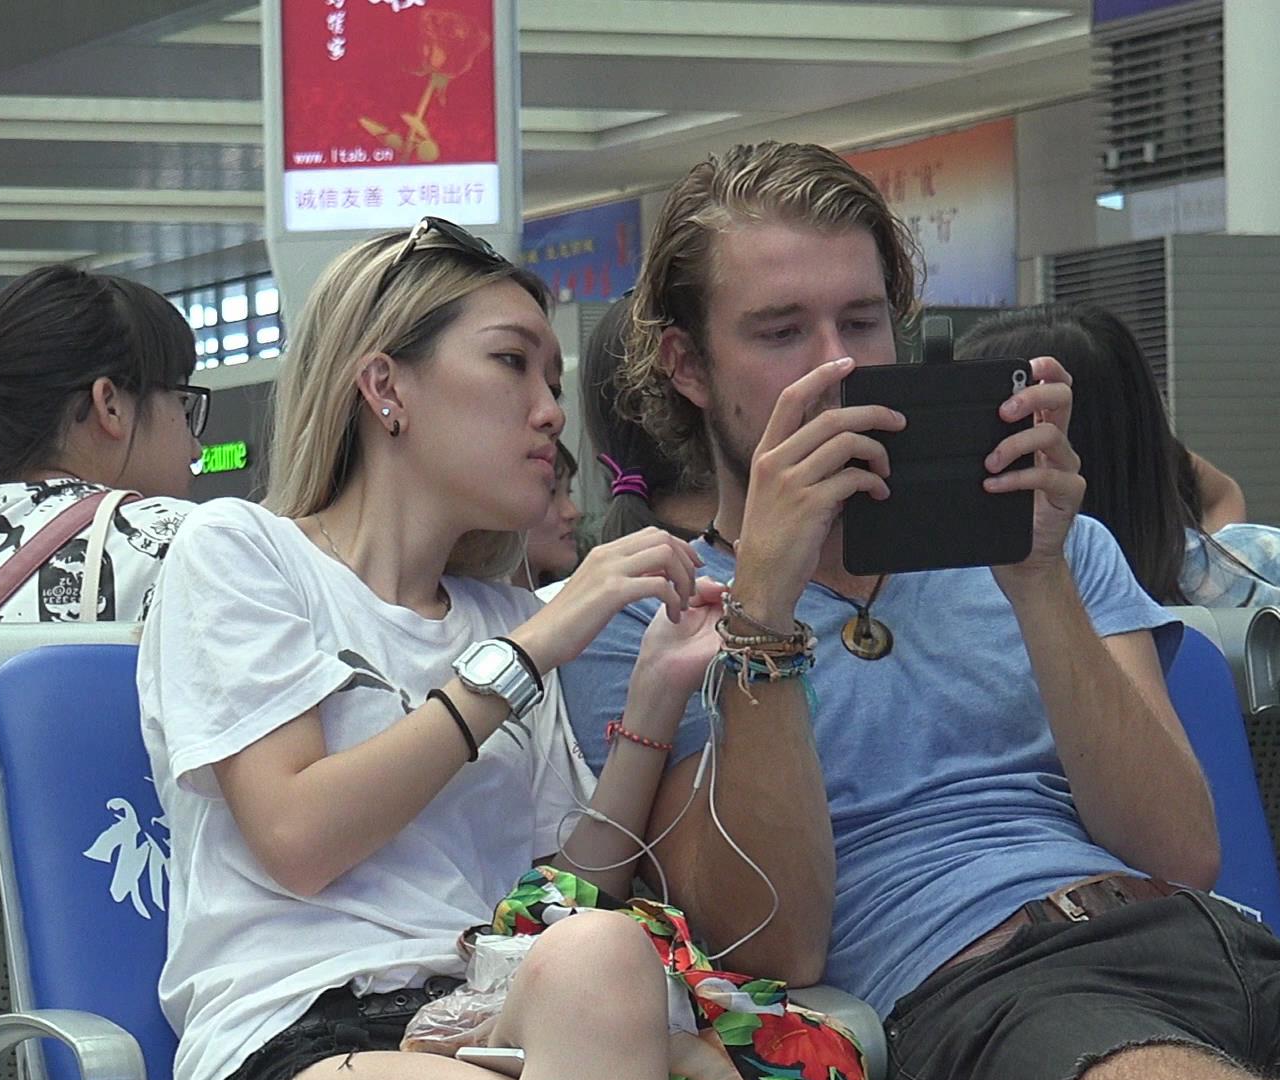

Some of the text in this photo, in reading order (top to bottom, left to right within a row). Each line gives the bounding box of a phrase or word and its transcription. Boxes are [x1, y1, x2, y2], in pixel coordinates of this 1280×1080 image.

[295, 182, 485, 210] 诚信友善 文明出行
